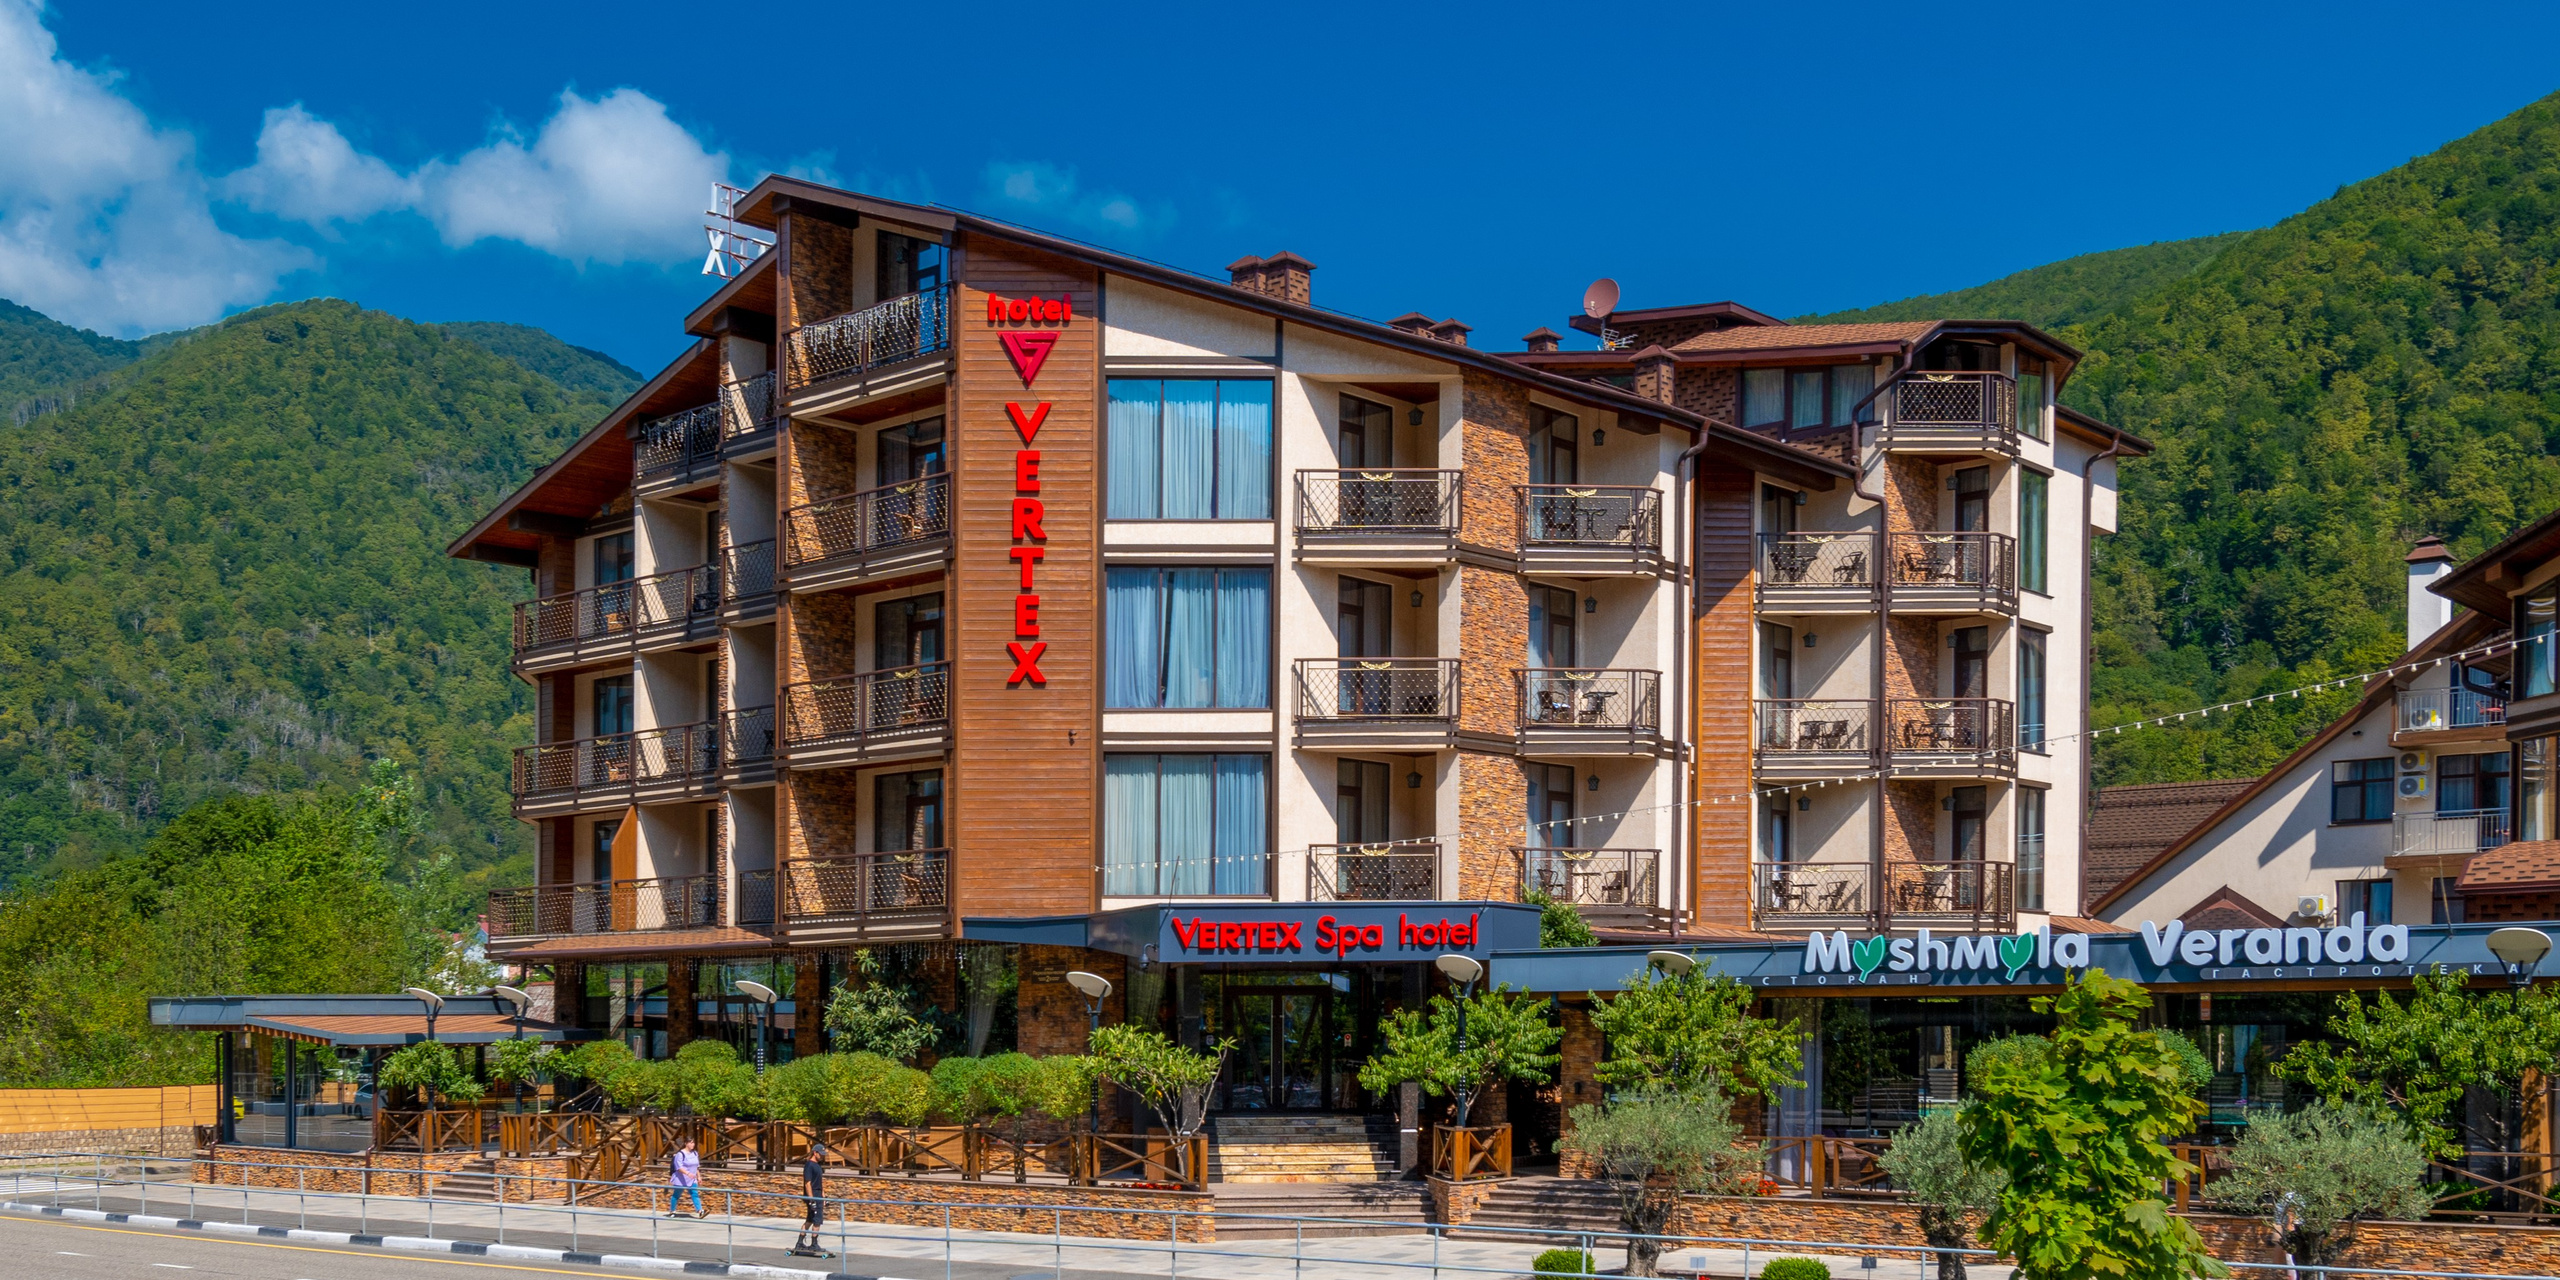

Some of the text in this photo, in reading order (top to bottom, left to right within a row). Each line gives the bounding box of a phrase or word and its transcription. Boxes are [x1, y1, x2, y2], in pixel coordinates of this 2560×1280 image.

[987, 292, 1072, 321] hotel
[1005, 402, 1052, 684] VERTEX
[1172, 913, 1479, 957] VERTEX Spa hotel
[2140, 910, 2409, 966] Veranda
[1709, 974, 1918, 986] ЕСТОРАН
[2212, 963, 2519, 979] ГАСТРОТЕКА
